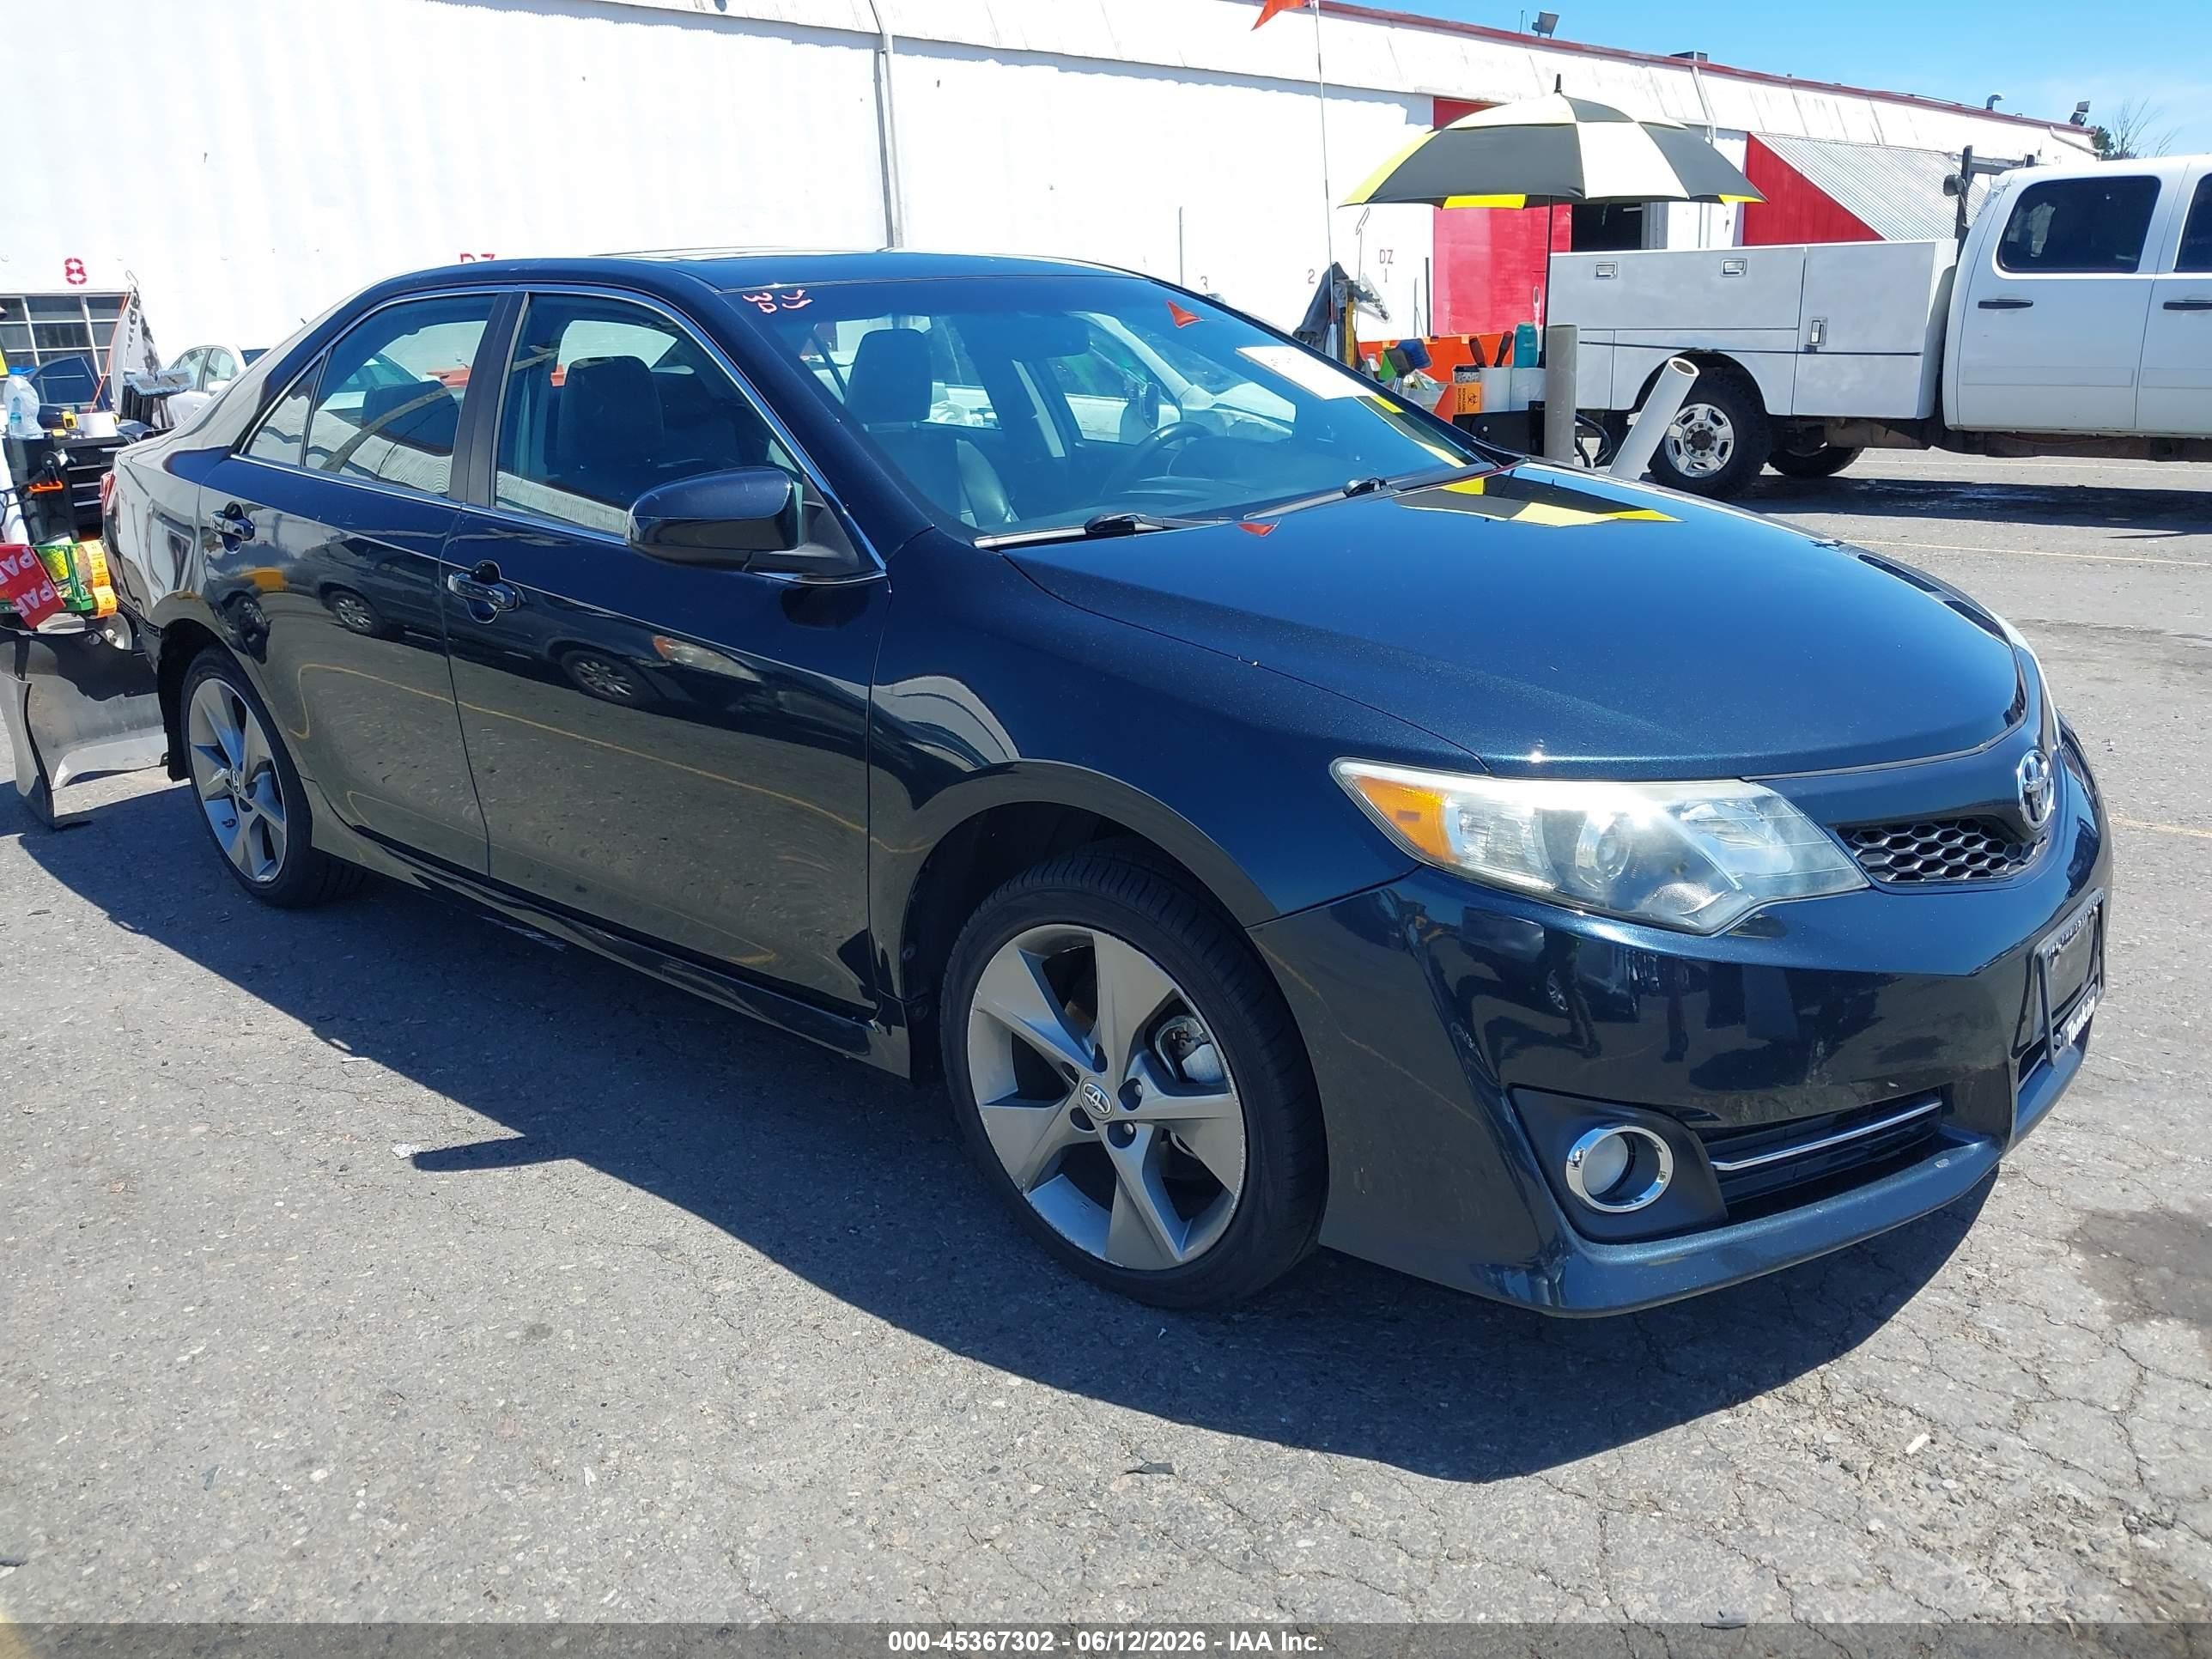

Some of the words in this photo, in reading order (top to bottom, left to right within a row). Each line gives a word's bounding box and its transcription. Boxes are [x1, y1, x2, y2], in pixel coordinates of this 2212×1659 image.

[1379, 249, 1394, 264] DZ
[64, 258, 88, 285] 8
[1307, 268, 1316, 284] 2
[2067, 996, 2095, 1046] Tonkin
